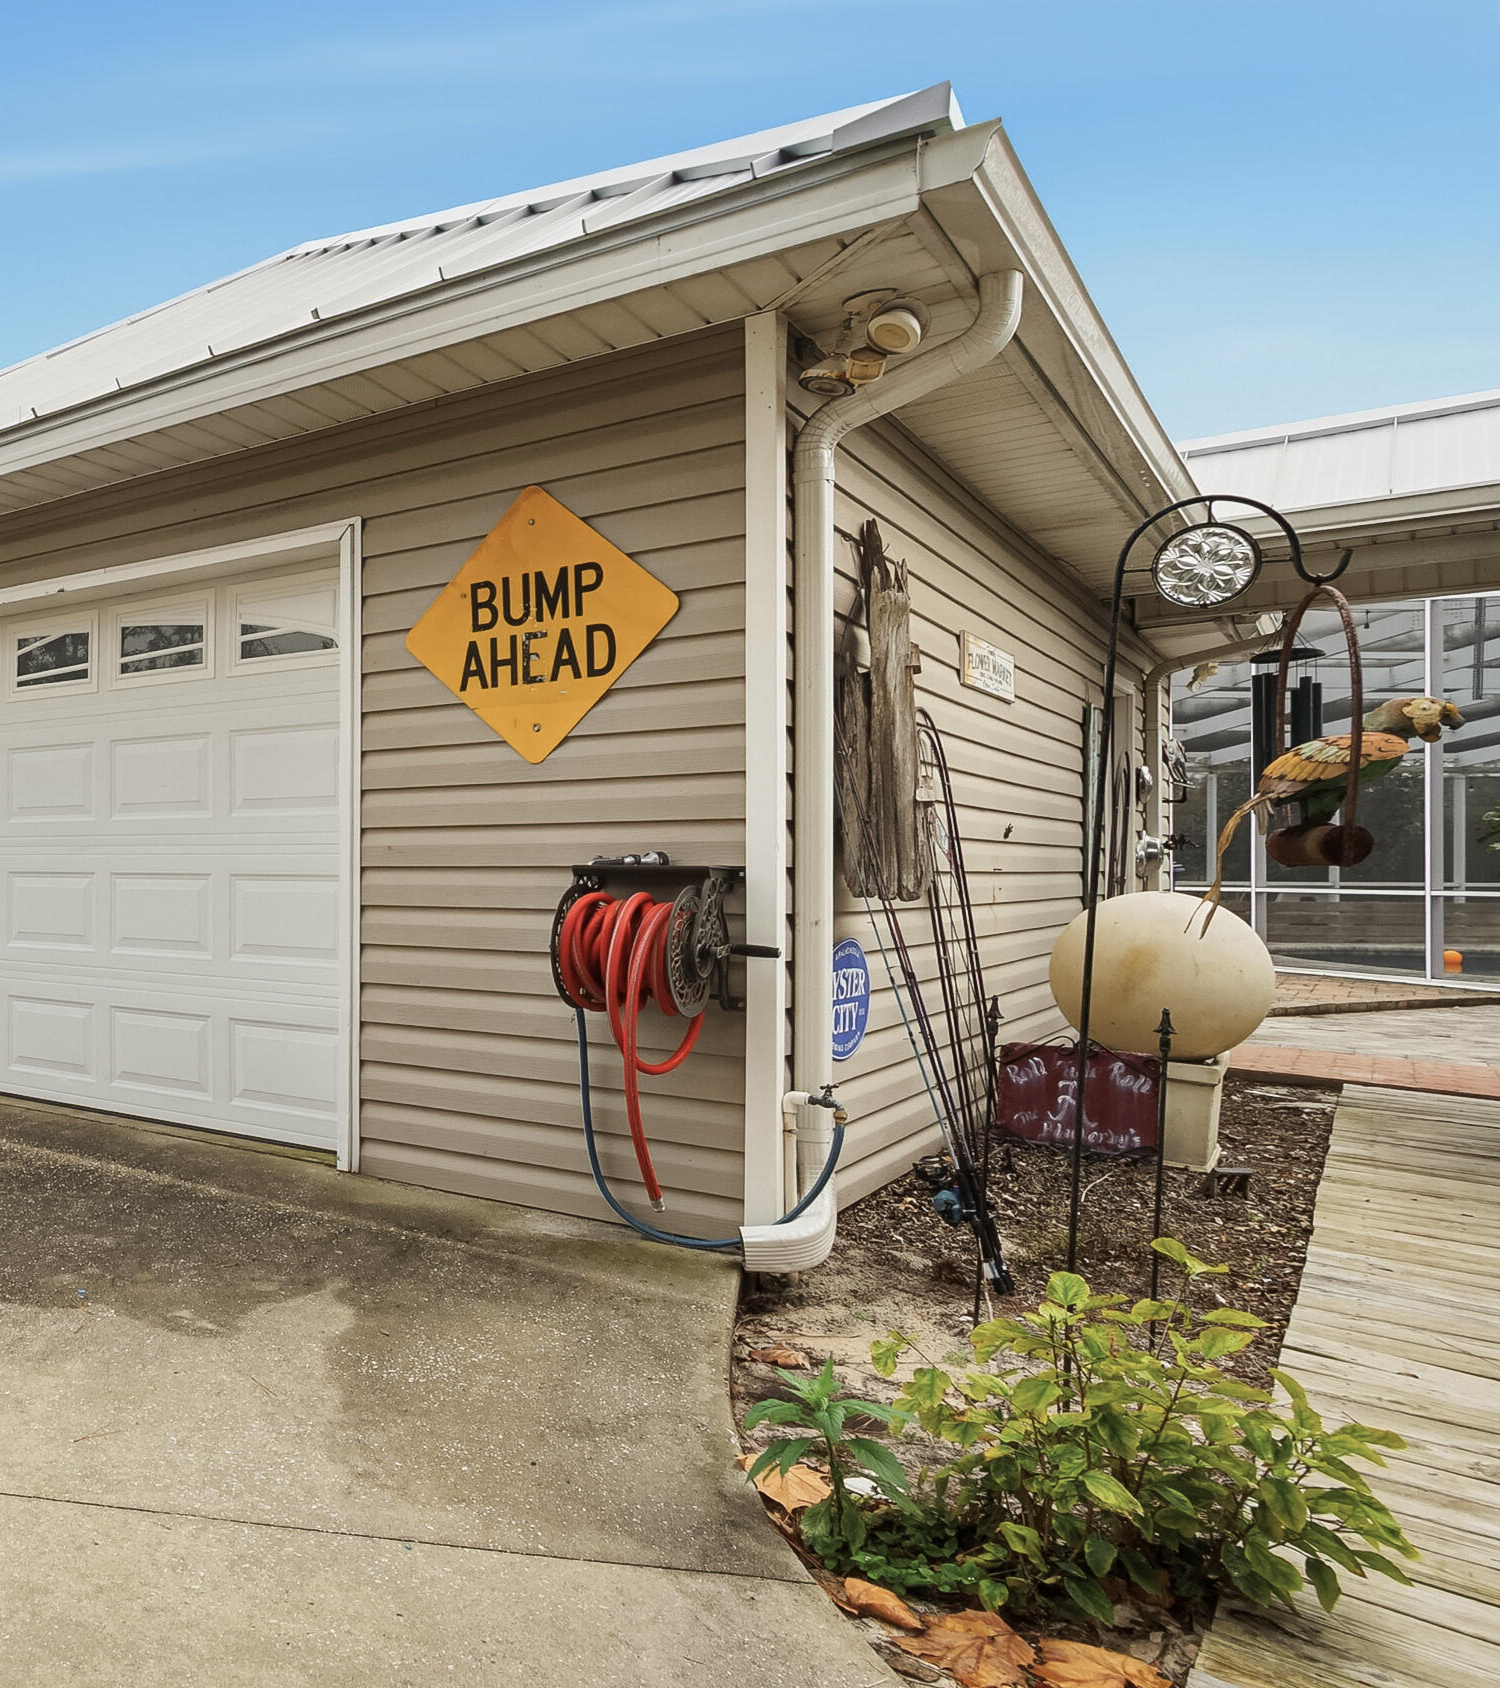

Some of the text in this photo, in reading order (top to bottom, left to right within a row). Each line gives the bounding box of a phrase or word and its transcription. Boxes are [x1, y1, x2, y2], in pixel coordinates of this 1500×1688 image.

[470, 561, 603, 633] BUMP
[459, 623, 617, 693] AHEAD
[832, 967, 866, 1001] YSTER
[832, 1001, 859, 1035] CITY
[1109, 1061, 1153, 1095] Roll
